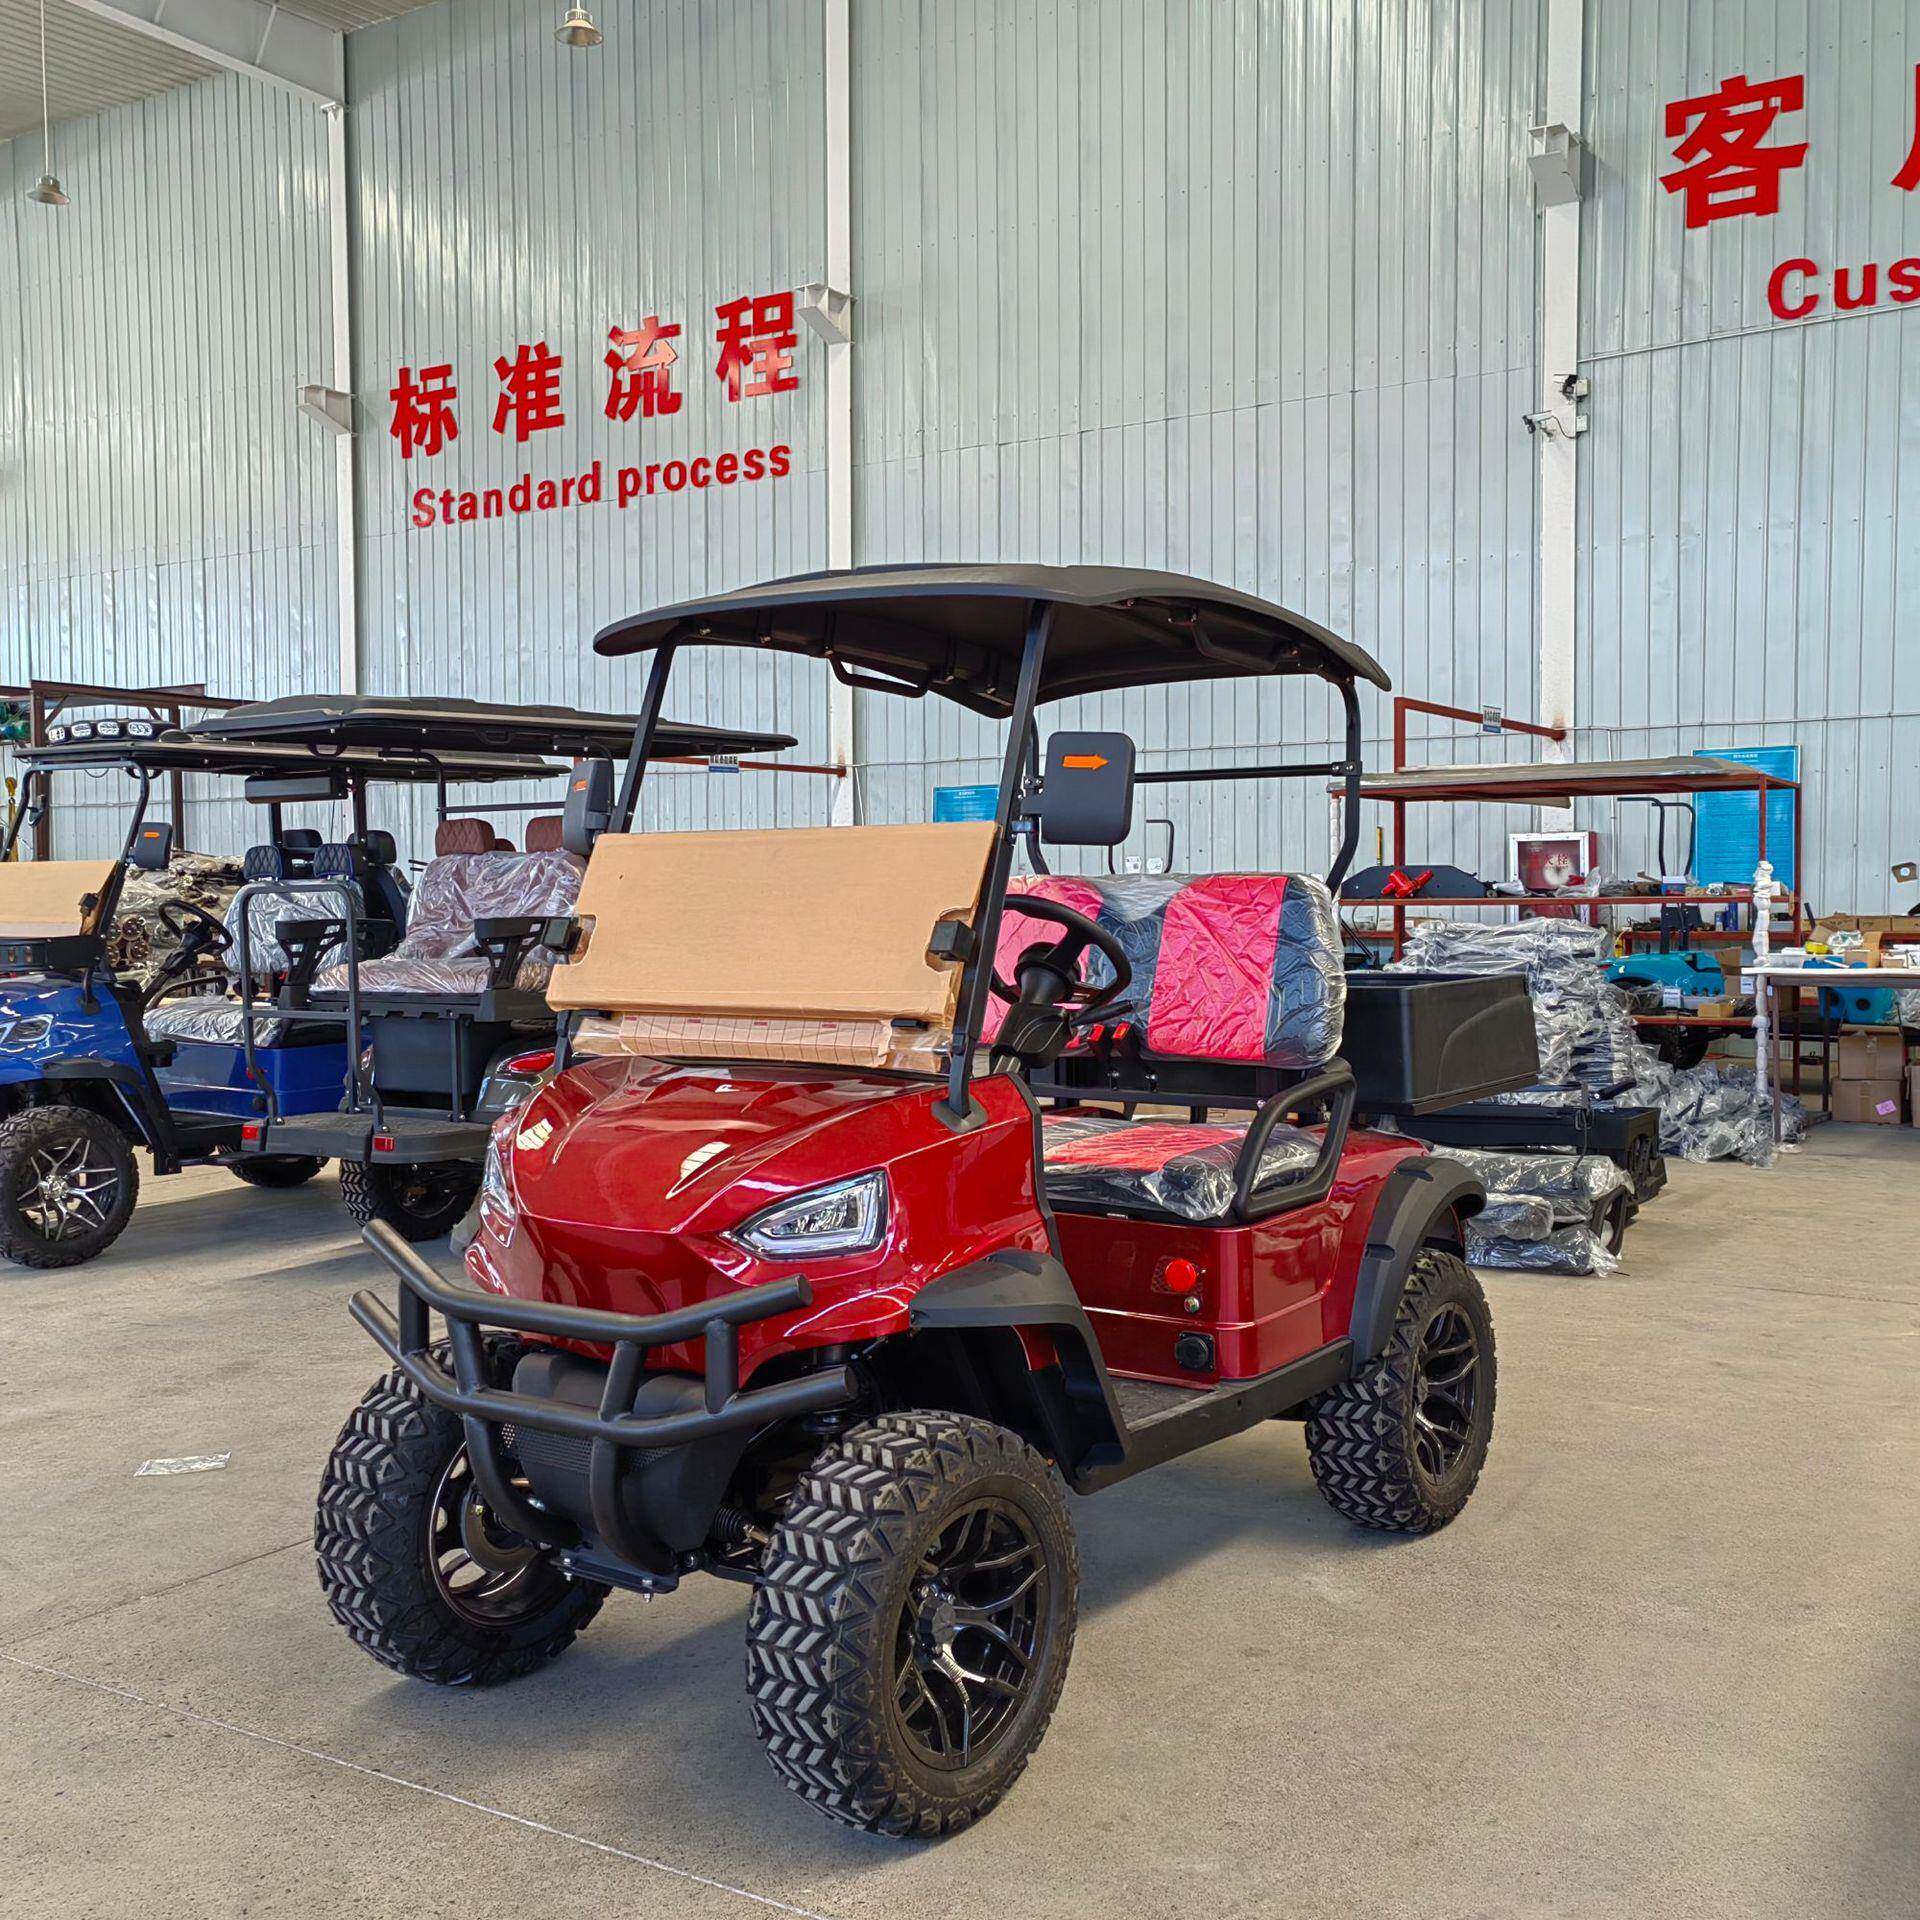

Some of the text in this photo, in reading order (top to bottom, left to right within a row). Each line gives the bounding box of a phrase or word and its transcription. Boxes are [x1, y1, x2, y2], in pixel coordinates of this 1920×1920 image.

[1659, 65, 1920, 229] 客
[1767, 257, 1920, 320] Cus
[390, 292, 799, 459] 标准流程
[411, 445, 792, 528] Standard process
